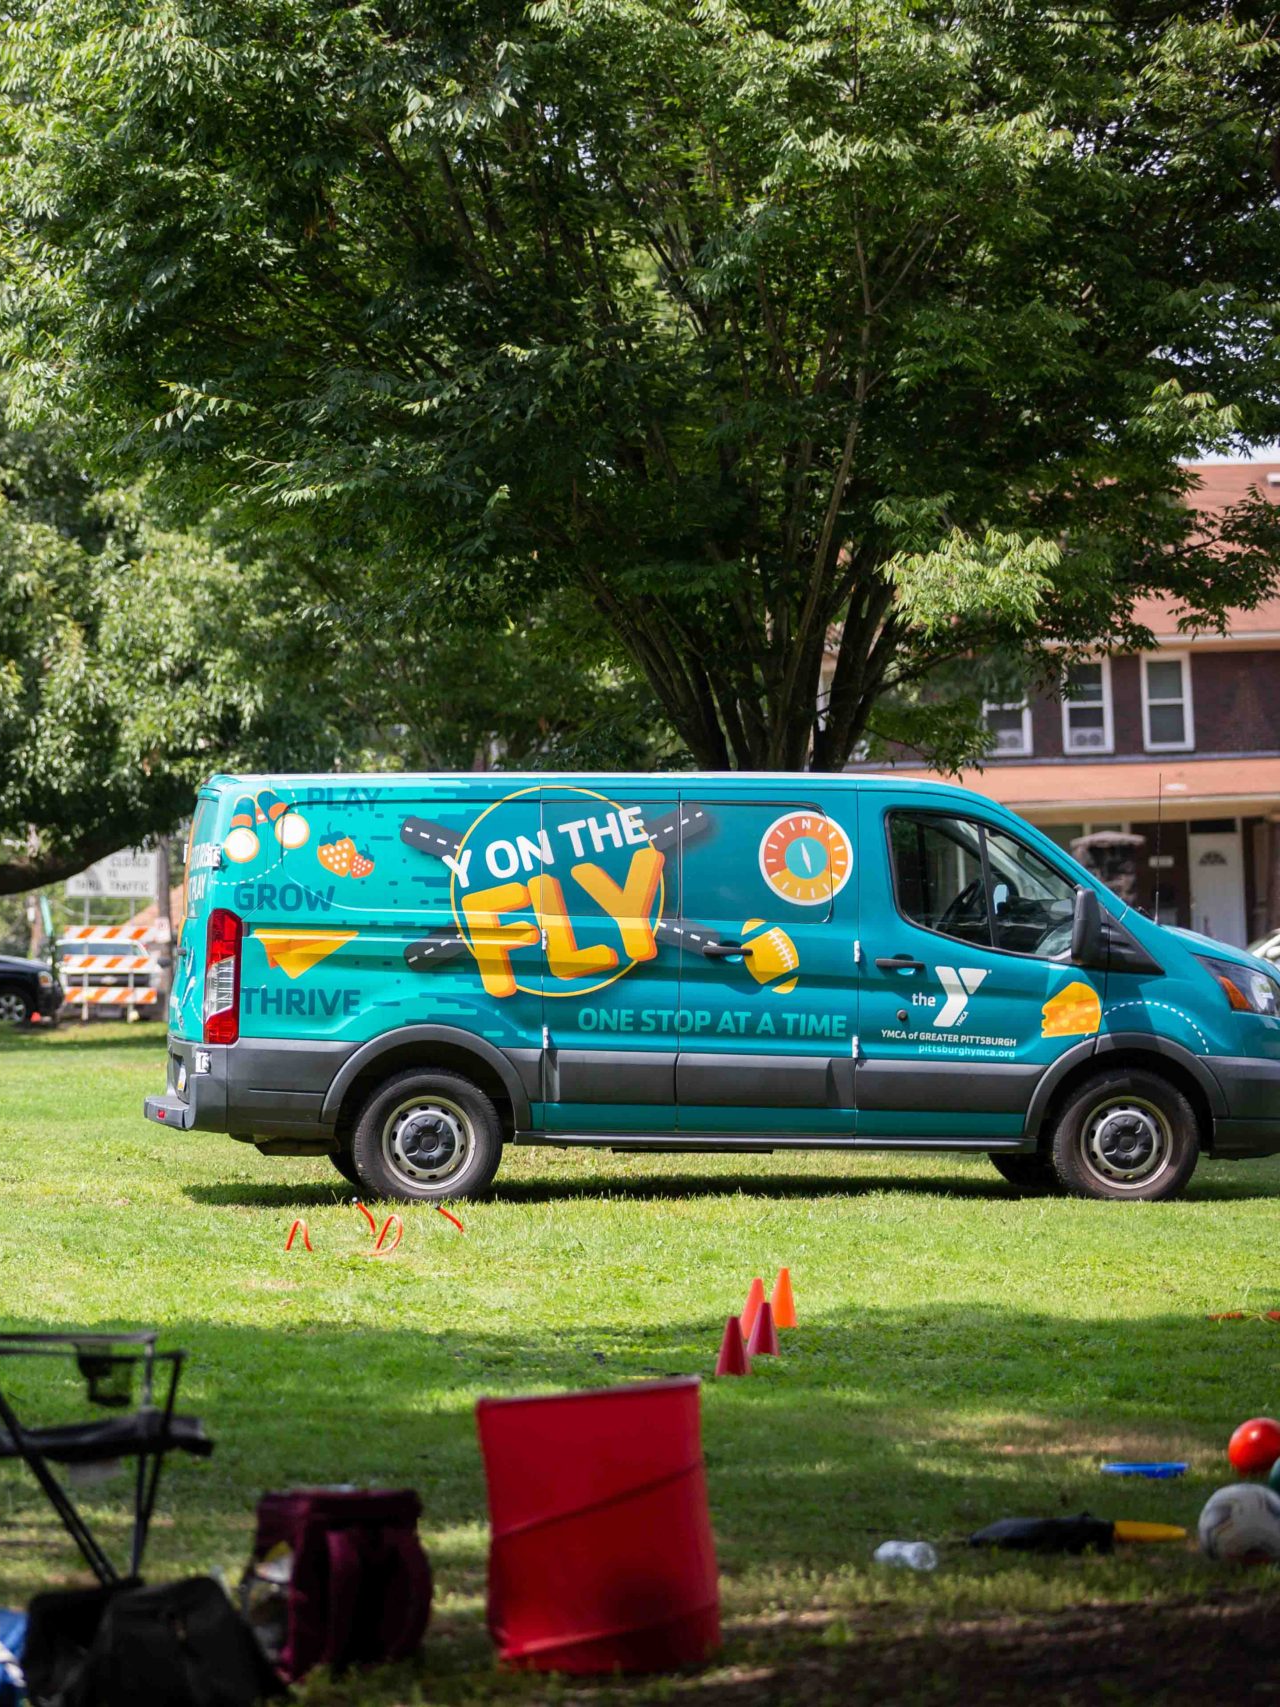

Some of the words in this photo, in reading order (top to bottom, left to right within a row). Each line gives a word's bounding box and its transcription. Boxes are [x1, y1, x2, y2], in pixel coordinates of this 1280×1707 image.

[306, 787, 382, 812] PLAY
[801, 818, 811, 829] N
[442, 849, 472, 888] Y
[485, 829, 555, 879] ON
[558, 806, 649, 857] THE
[233, 883, 336, 912] GROW
[461, 847, 666, 998] FLY
[241, 987, 361, 1017] THRIVE
[912, 992, 936, 1007] the
[578, 1007, 634, 1032] ONE
[640, 1009, 711, 1033] STOP
[716, 1010, 751, 1034] AT
[756, 1011, 776, 1035] A
[782, 1013, 847, 1037] TIME
[955, 1010, 969, 1027] YMCA
[881, 1029, 907, 1039] YMCA
[908, 1031, 919, 1040] of
[919, 1032, 959, 1043] GREATER
[960, 1035, 1017, 1047] PITTSBURGH
[918, 1044, 1016, 1060] pittsburghymca.org
